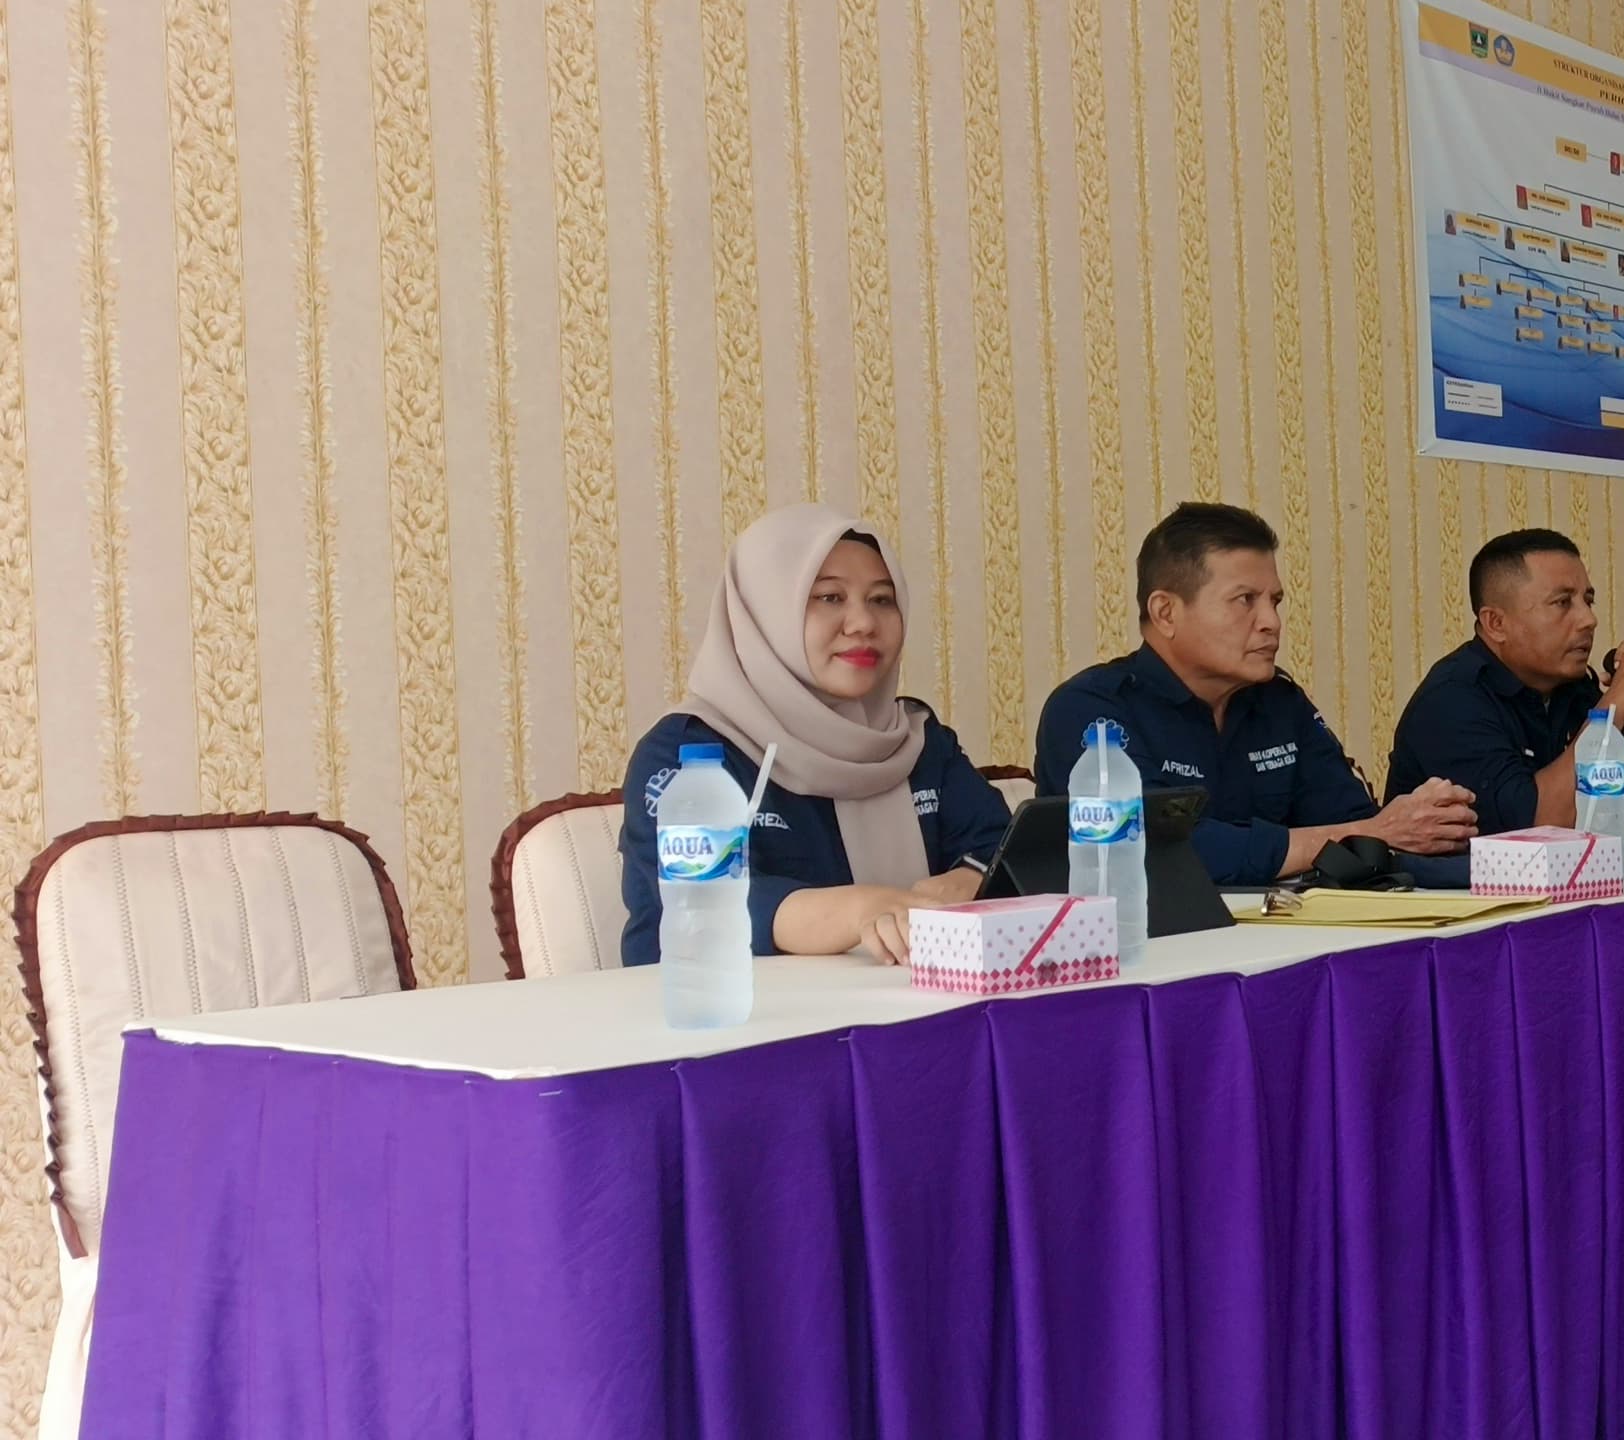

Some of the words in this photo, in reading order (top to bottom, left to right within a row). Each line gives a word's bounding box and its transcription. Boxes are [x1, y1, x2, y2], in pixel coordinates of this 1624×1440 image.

[1161, 759, 1204, 778] AFRIZAL
[1591, 767, 1623, 782] AQUA
[1074, 806, 1114, 825] AQUA
[662, 836, 714, 859] AQUA
